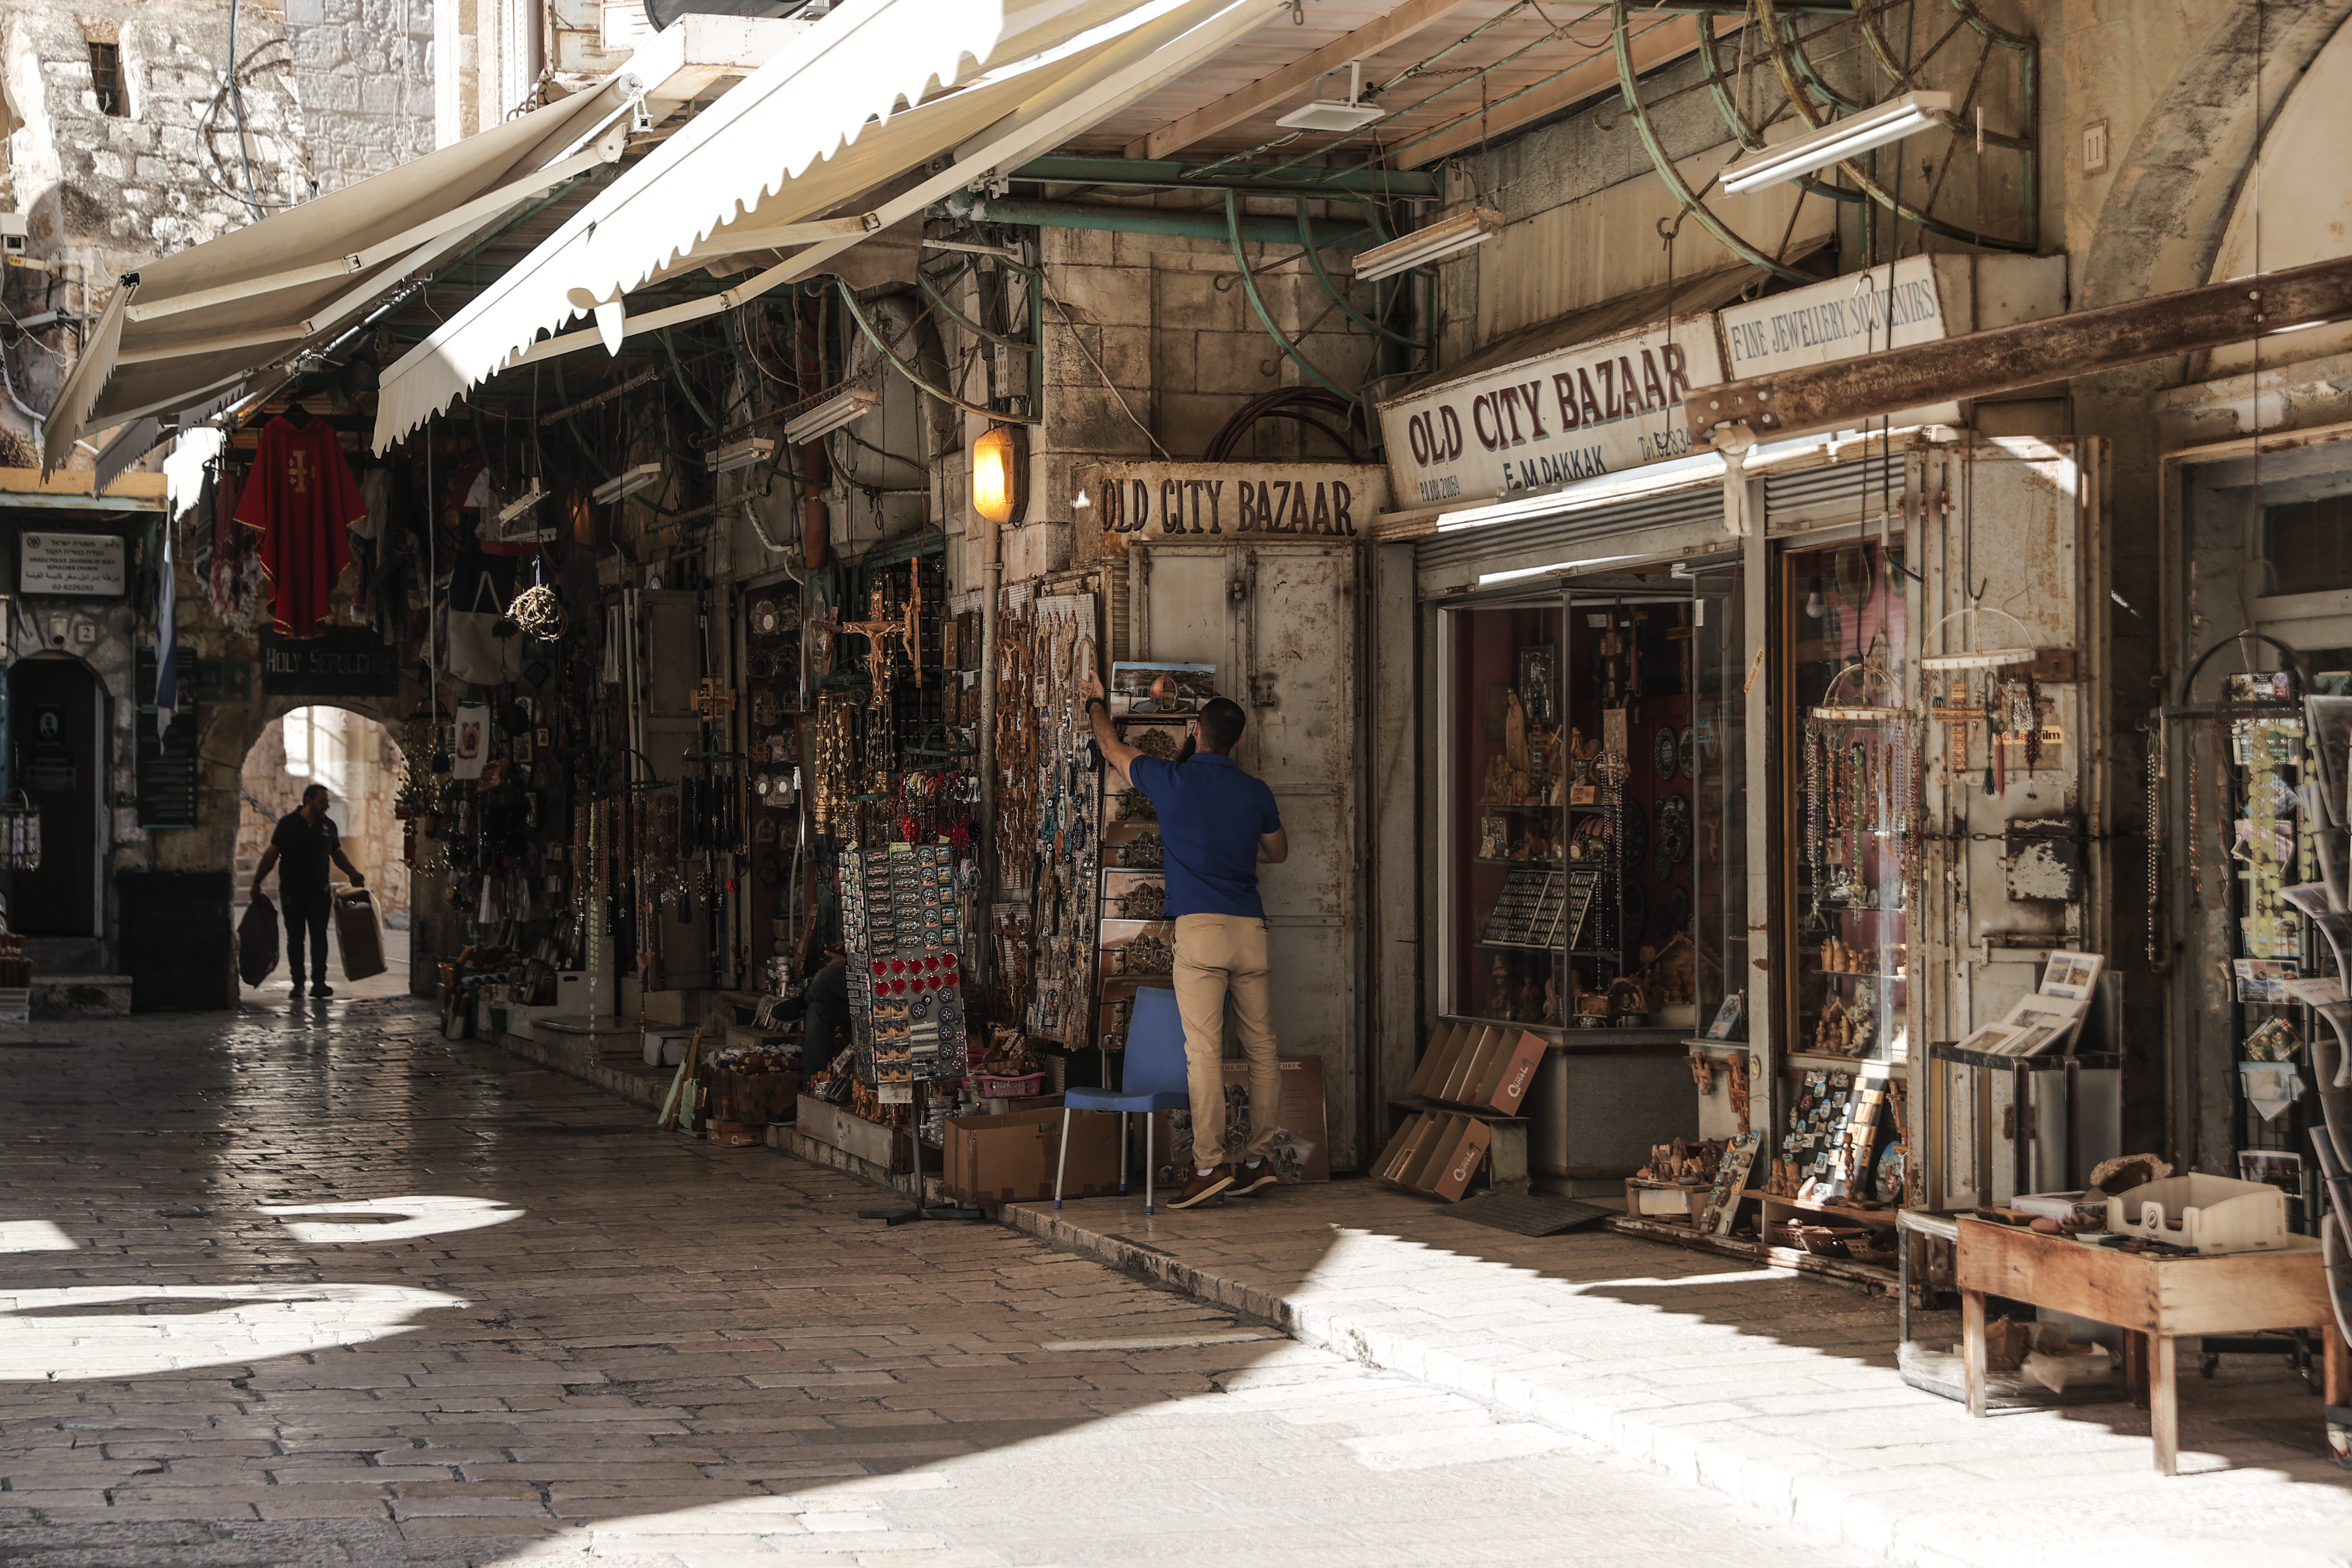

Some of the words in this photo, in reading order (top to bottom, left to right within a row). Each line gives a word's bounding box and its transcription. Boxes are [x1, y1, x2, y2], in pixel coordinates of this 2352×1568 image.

[2087, 135, 2100, 162] 11
[1731, 320, 1768, 361] FINE
[1850, 278, 1935, 335] SOUVENIRS
[1409, 405, 1463, 468] OLD
[1473, 380, 1550, 452] CITY
[1552, 343, 1690, 432] BAZAAR
[1103, 478, 1148, 532] OLD
[1160, 479, 1224, 534] CITY
[1237, 480, 1357, 536] BAZAAR
[1440, 475, 1460, 499] 20059
[266, 648, 301, 673] HOLY
